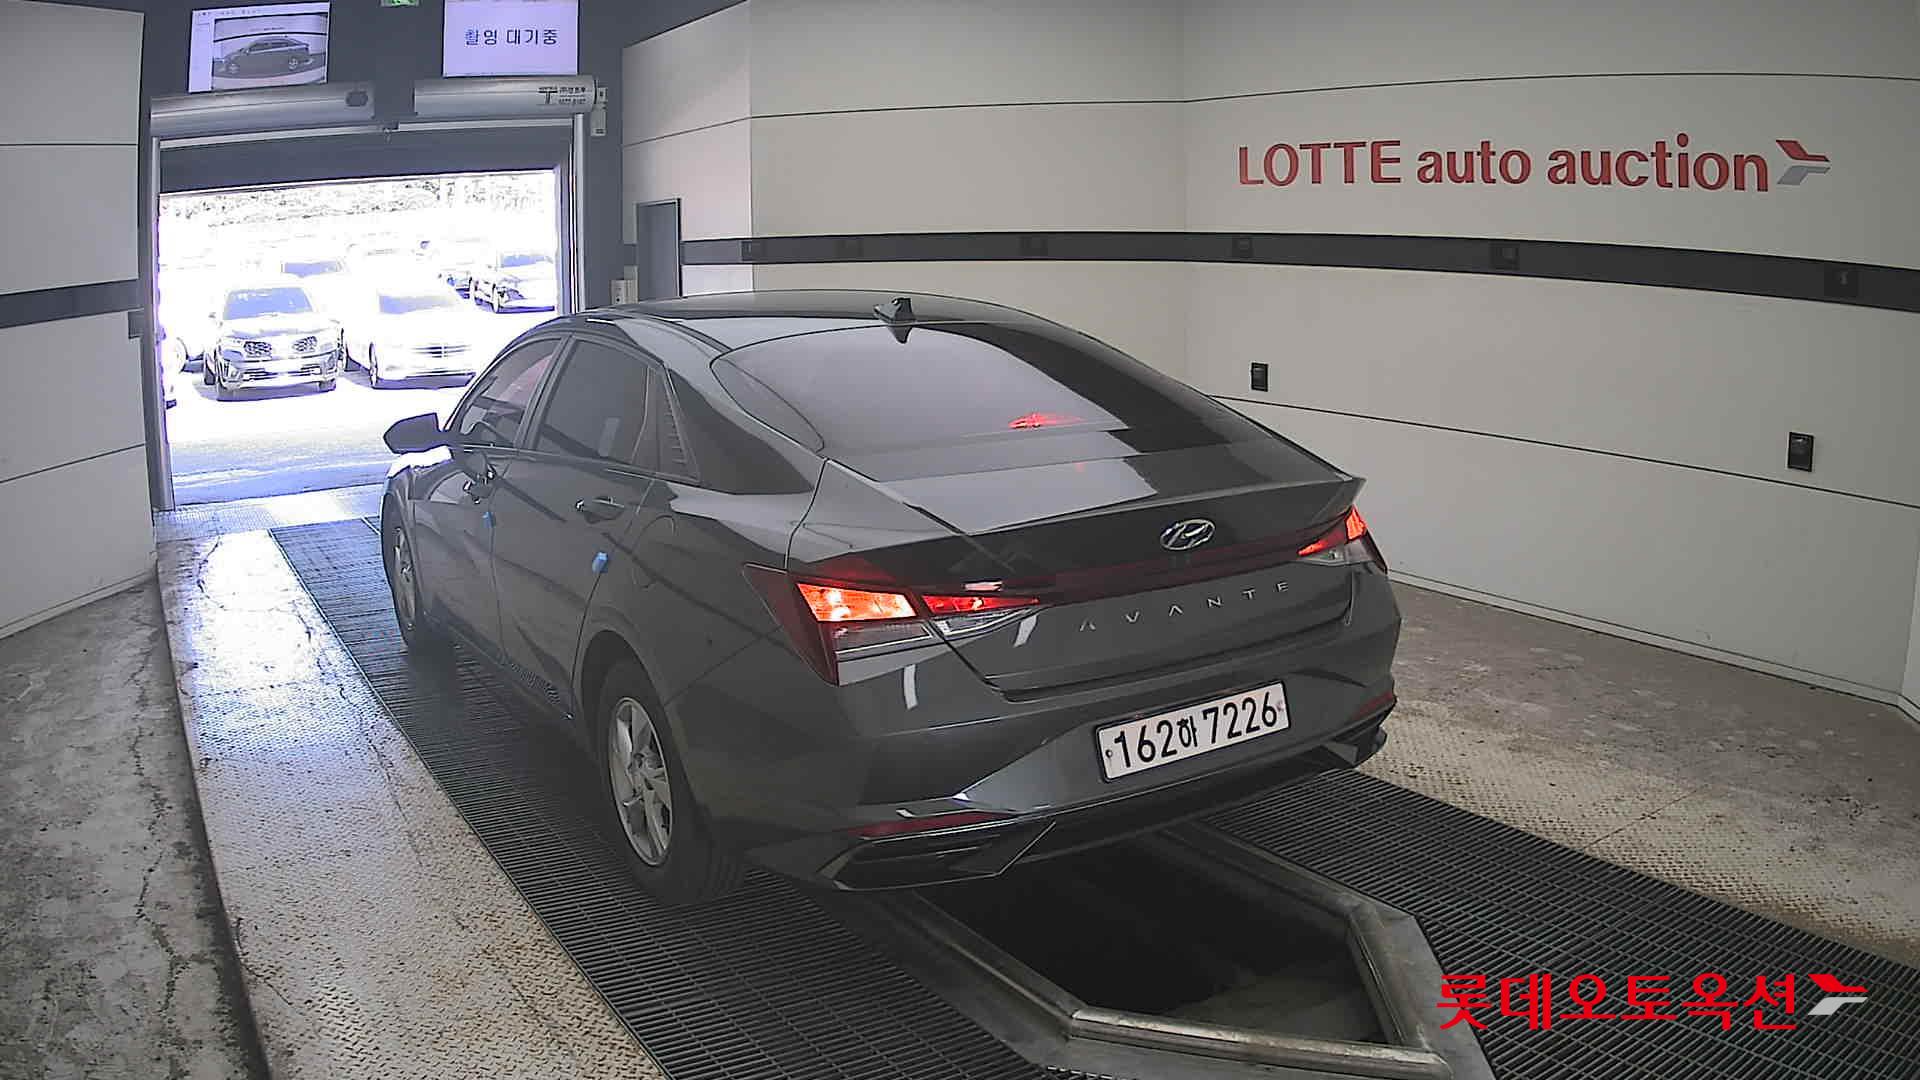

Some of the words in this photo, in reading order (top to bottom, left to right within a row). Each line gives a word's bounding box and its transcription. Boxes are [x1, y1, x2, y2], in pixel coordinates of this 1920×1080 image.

[506, 29, 558, 46] 대기중
[1239, 139, 1401, 187] LOTTE
[1416, 140, 1532, 185] auto
[1547, 132, 1769, 193] auction
[1079, 580, 1289, 632] AVANTE
